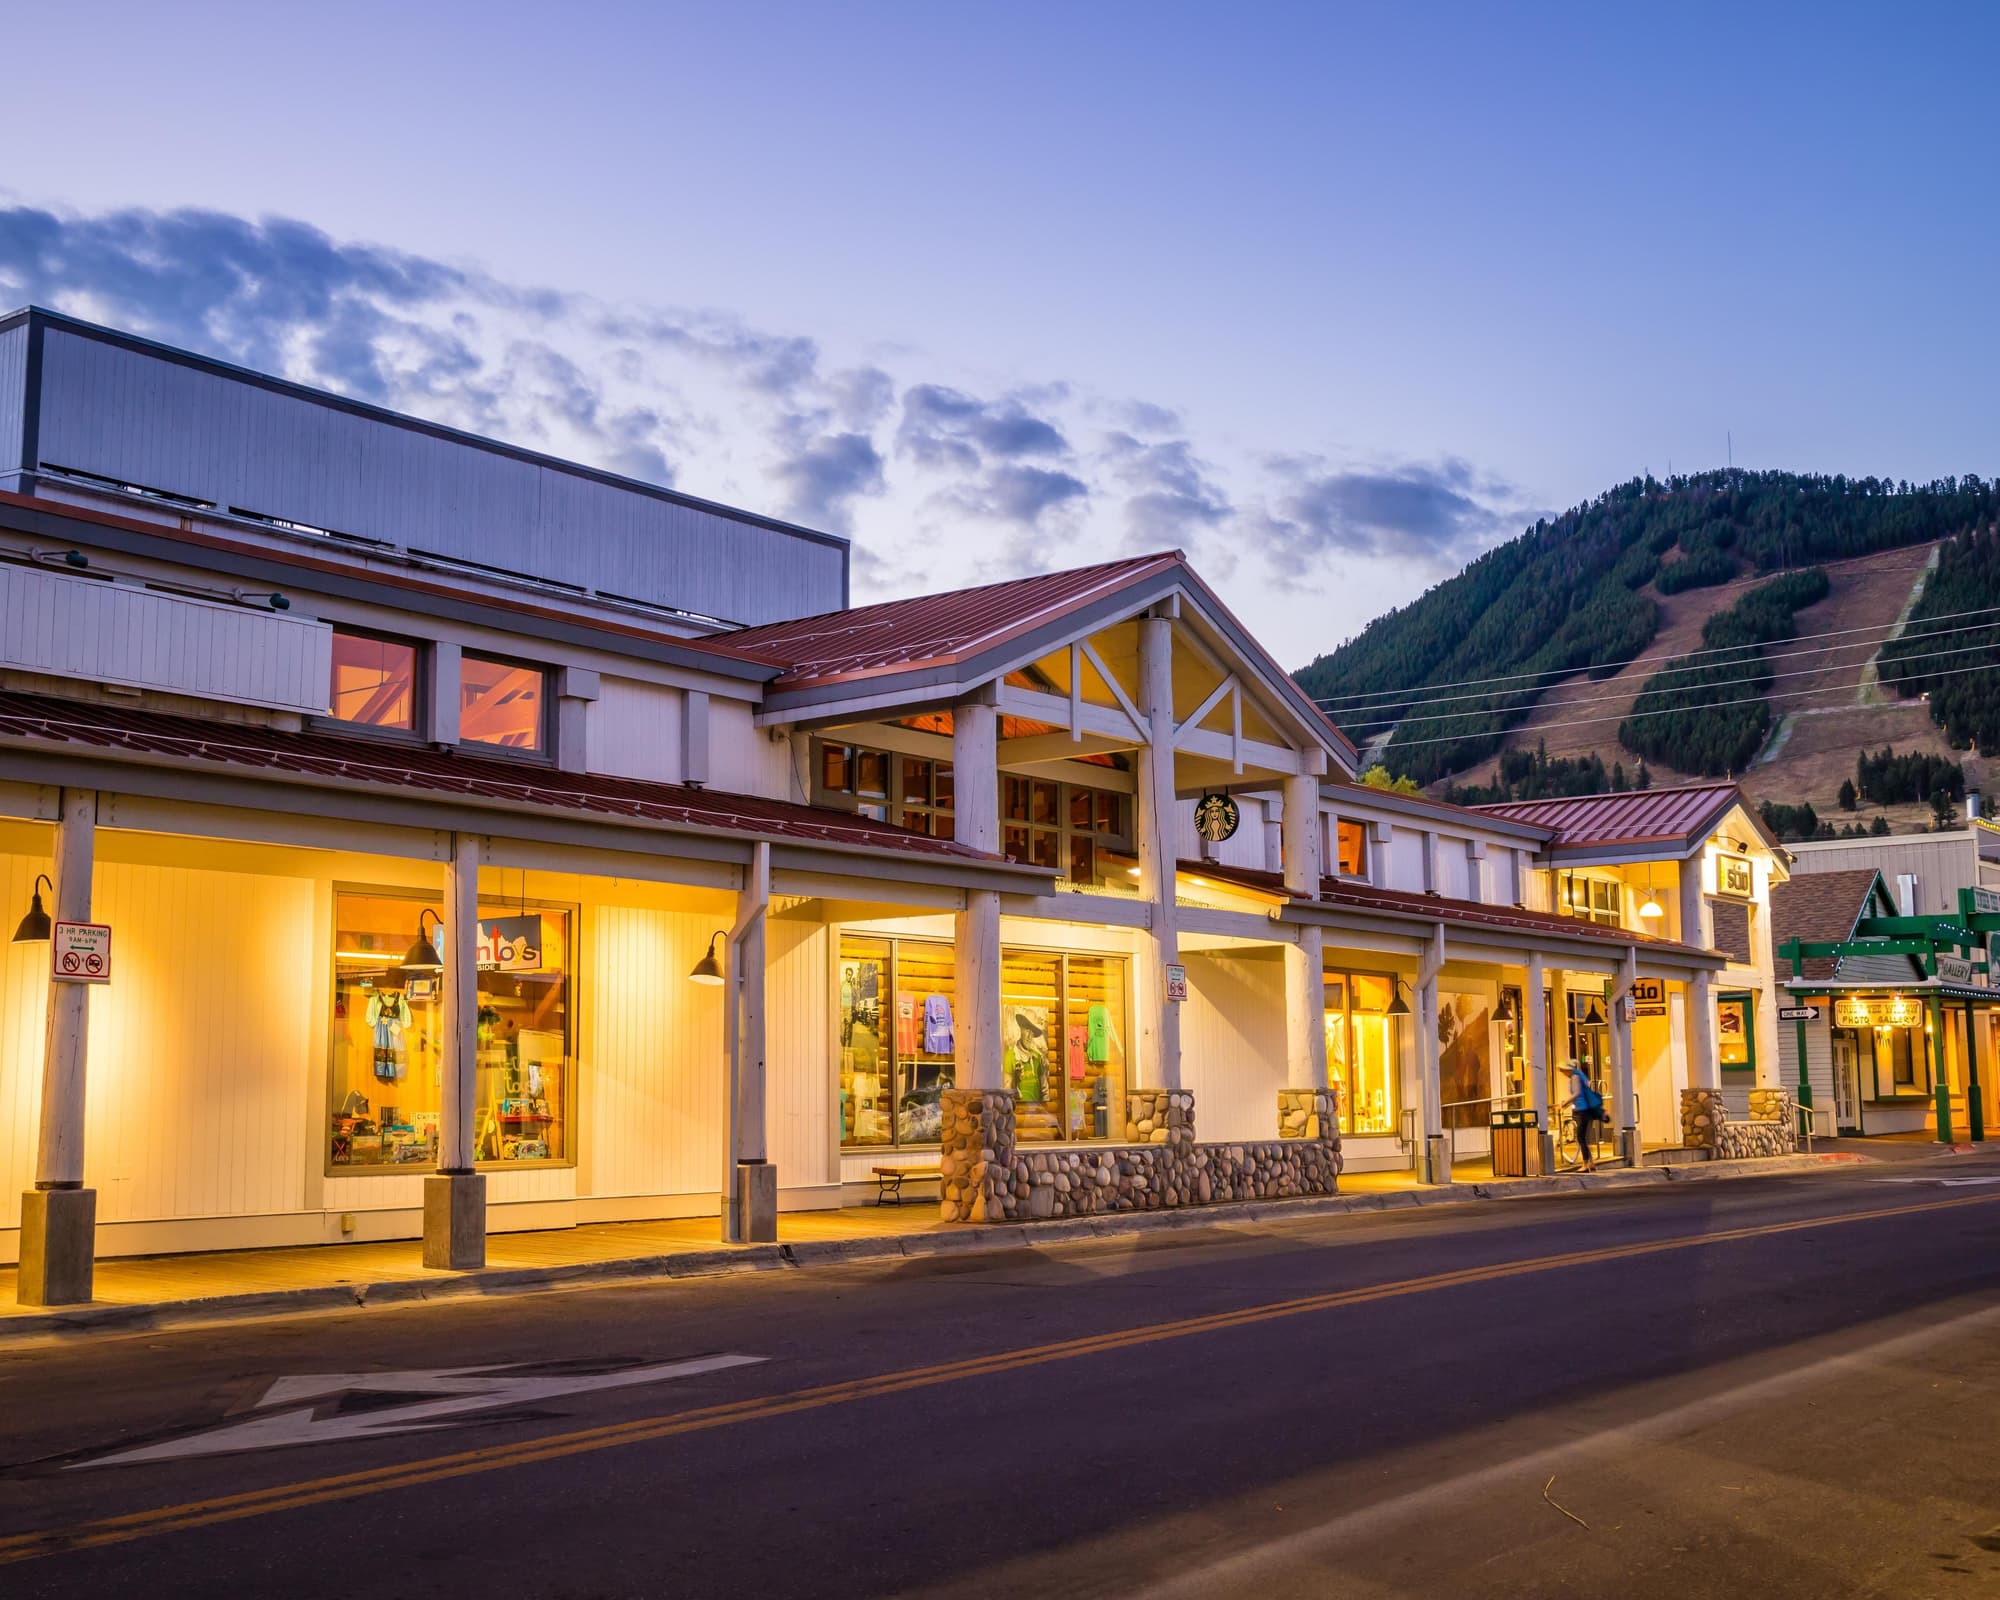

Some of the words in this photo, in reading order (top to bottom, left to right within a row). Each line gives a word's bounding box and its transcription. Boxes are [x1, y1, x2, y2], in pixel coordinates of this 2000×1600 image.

[67, 927, 76, 935] HR
[79, 929, 107, 938] PARKING
[1943, 962, 1970, 980] GALLERY
[1629, 983, 1658, 999] tio
[1842, 1016, 1870, 1024] PHOTO
[1877, 1016, 1916, 1024] GALLERY
